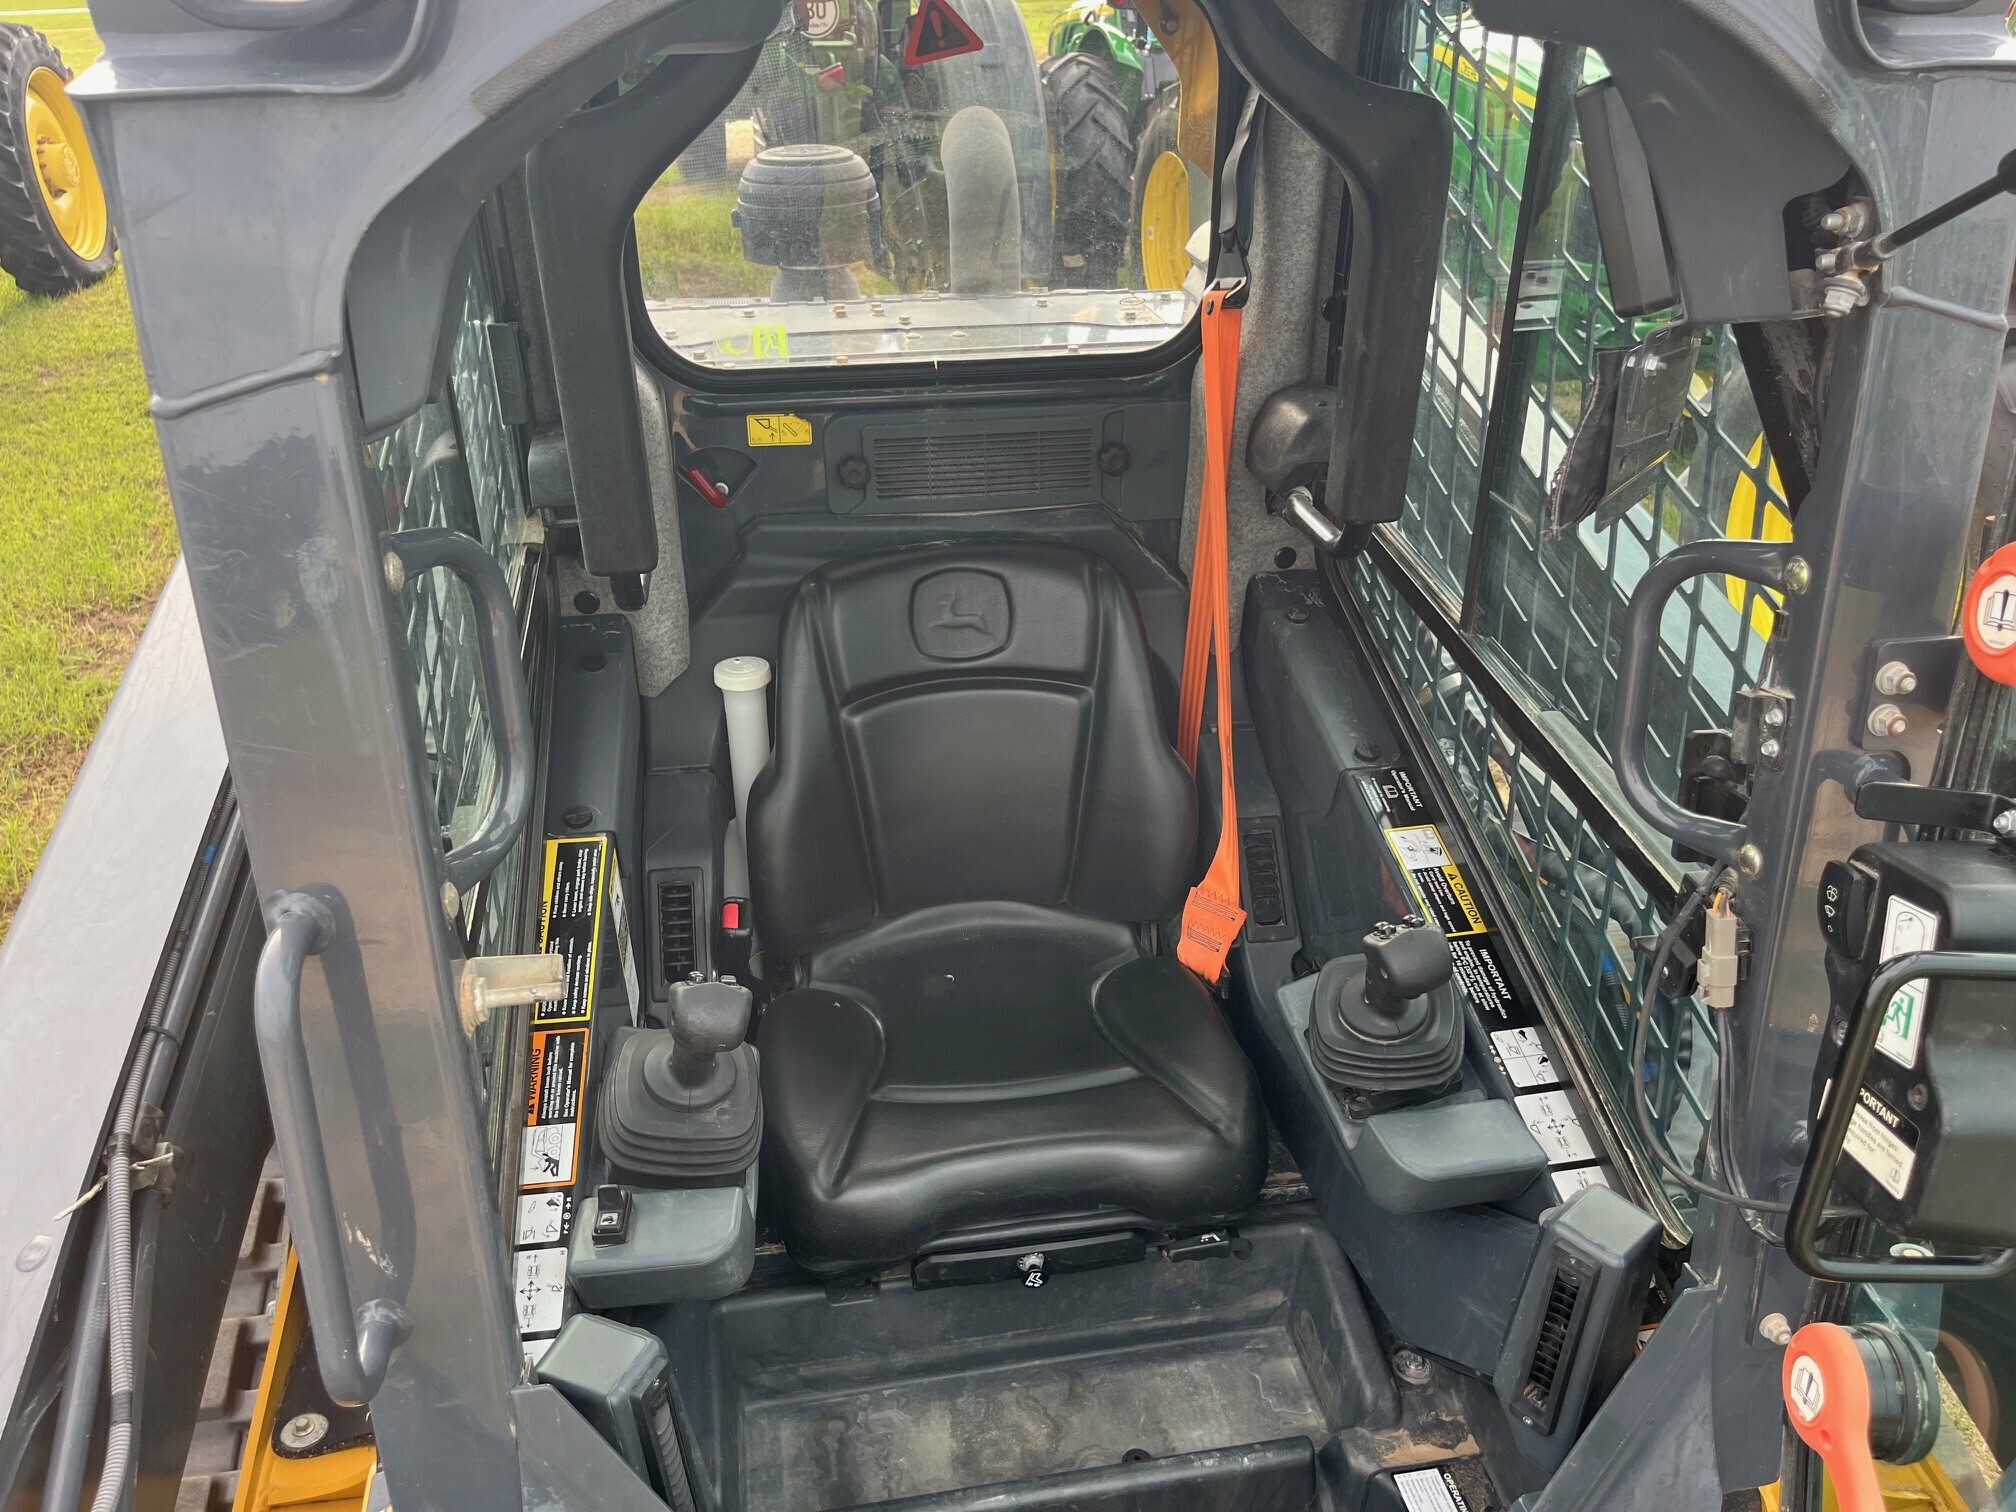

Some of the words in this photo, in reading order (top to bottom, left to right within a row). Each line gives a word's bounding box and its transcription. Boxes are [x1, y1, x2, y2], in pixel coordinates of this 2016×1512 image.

[1399, 772, 1422, 807] IMPORTANT
[1454, 883, 1481, 924] CAUTION
[1468, 947, 1480, 965] prevent
[1478, 965, 1491, 985] damage
[1490, 992, 1508, 1019] hydraulics
[1479, 950, 1511, 999] IMPORTANT
[529, 1049, 540, 1100] WARNING
[1860, 1088, 1899, 1128] PORTANT
